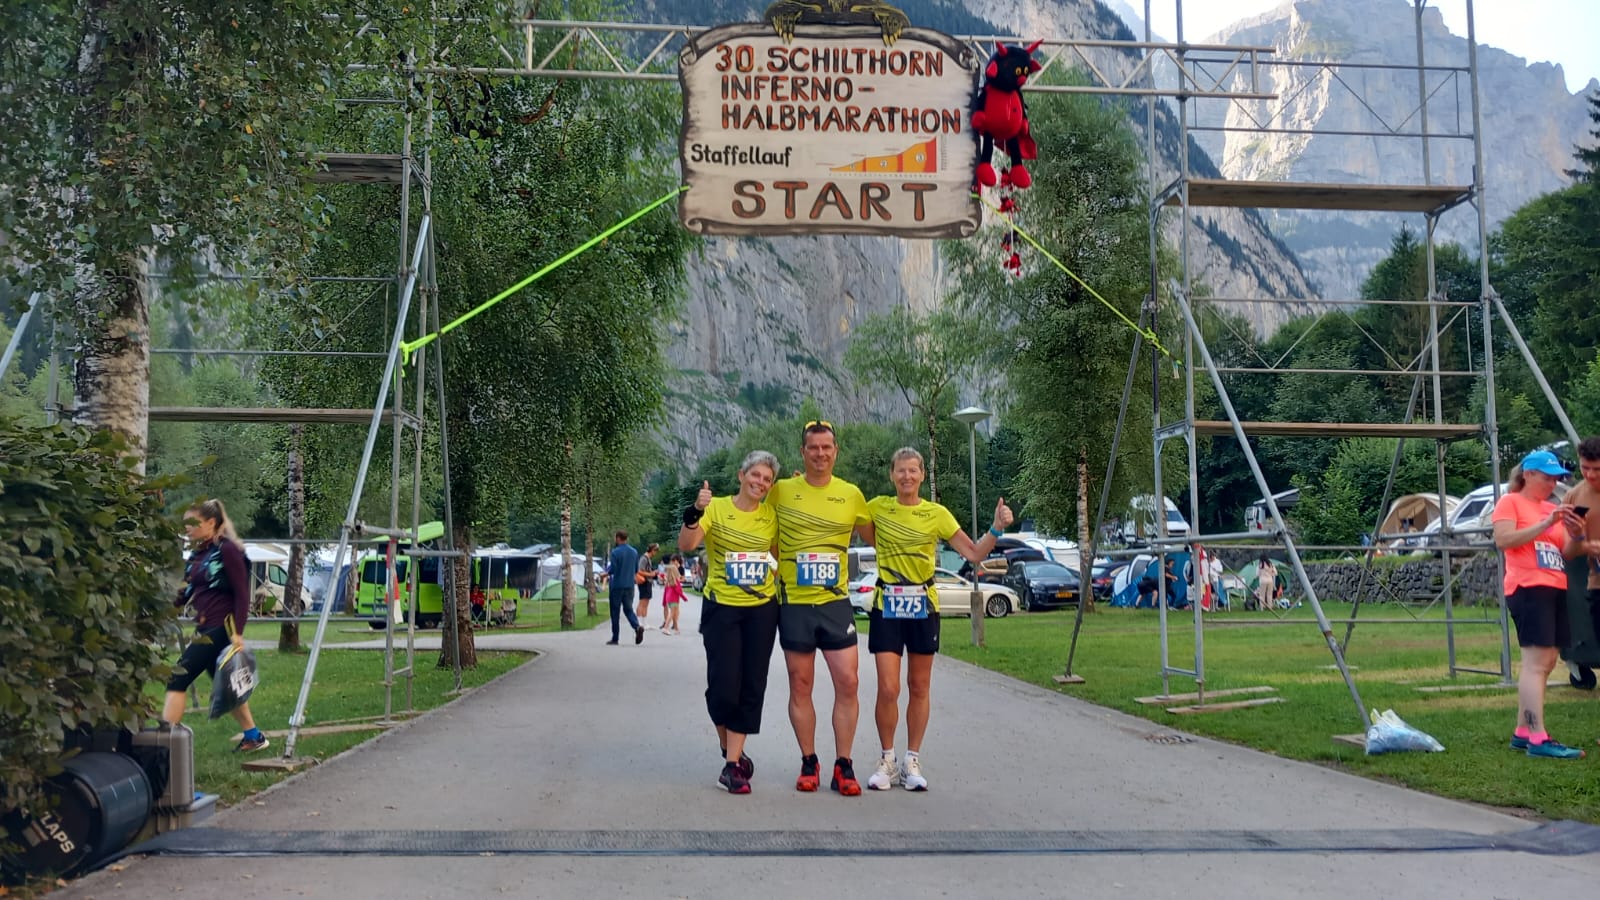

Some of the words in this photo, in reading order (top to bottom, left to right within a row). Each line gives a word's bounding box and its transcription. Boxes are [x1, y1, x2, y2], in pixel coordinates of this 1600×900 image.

[721, 103, 961, 135] HALBMARATHON
[690, 143, 793, 168] Staffellauf
[731, 180, 938, 222] START
[731, 562, 765, 580] 1144
[802, 563, 836, 580] 1188
[888, 596, 922, 613] 1275
[41, 811, 76, 854] LAPS
